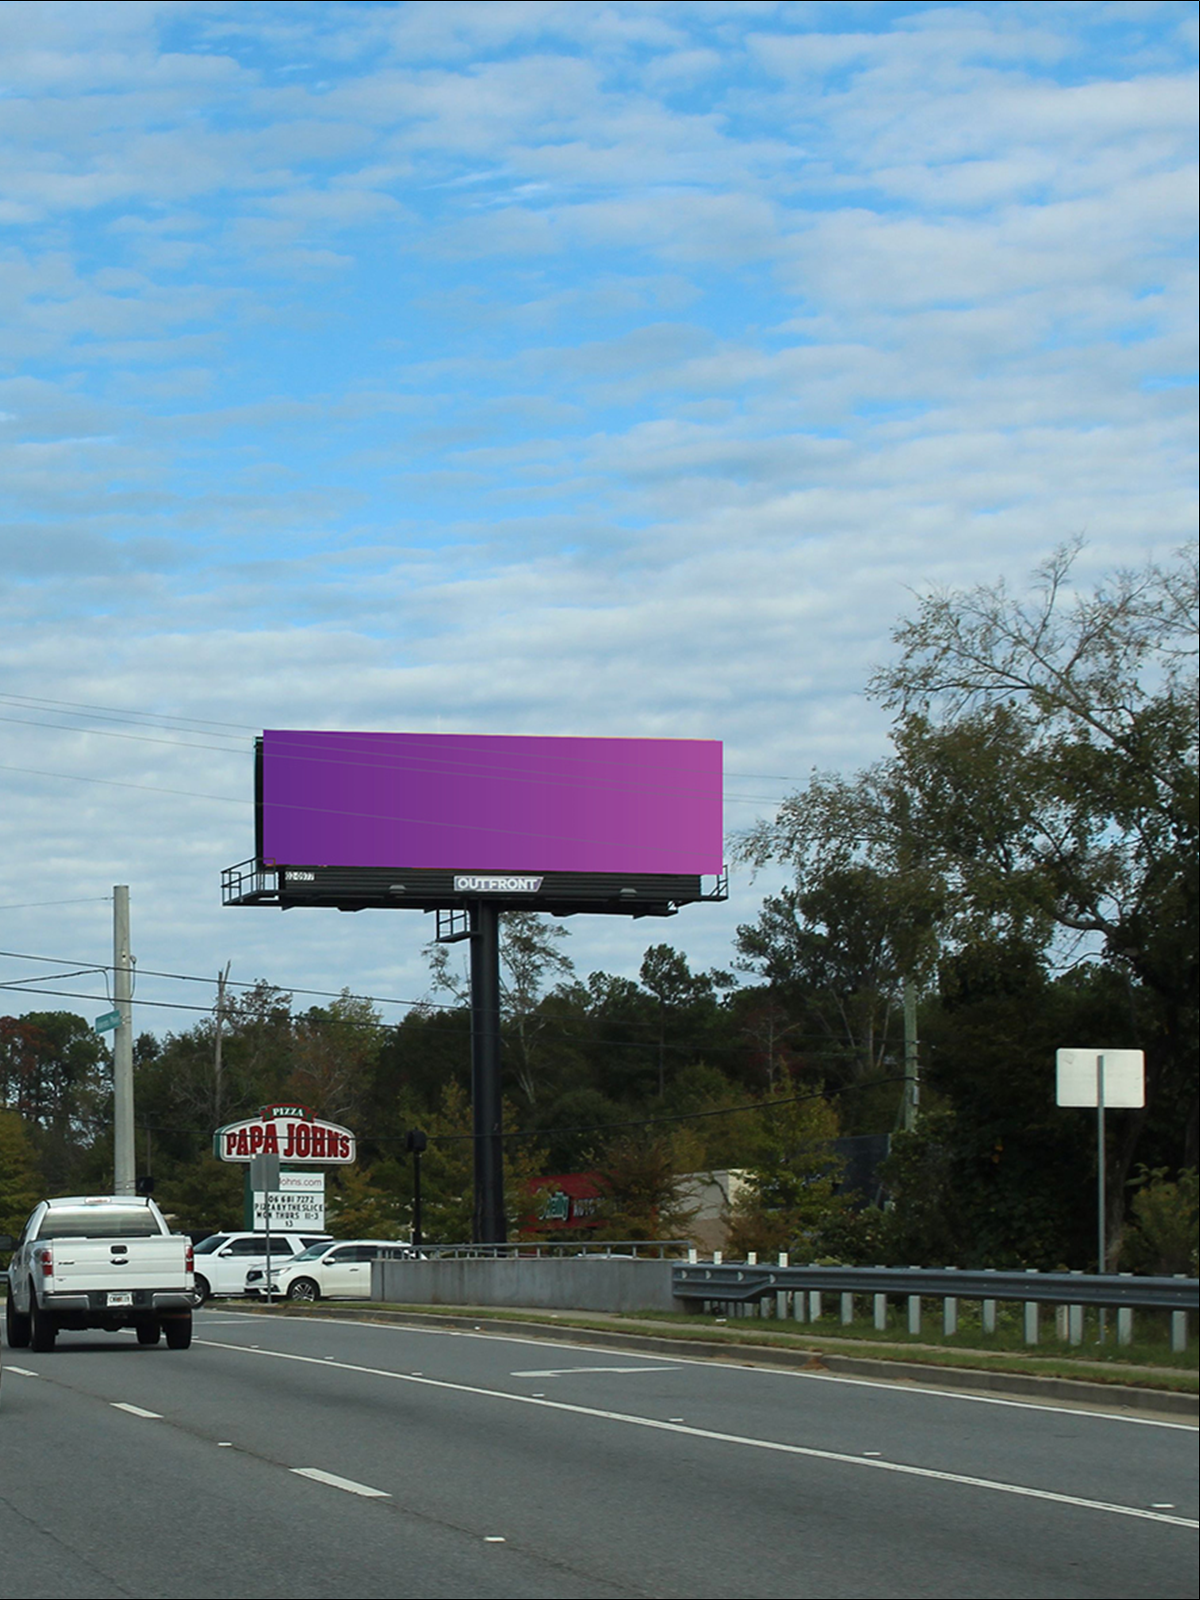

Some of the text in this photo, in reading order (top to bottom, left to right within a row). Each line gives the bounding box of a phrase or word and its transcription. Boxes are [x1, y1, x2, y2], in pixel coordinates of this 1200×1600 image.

[458, 878, 538, 890] OUTFRONT
[272, 1107, 304, 1117] PIZZA
[226, 1123, 279, 1155] PAPA
[279, 1178, 322, 1187] ohns.com
[302, 1204, 323, 1212] SLICE
[276, 1211, 300, 1219] THURS
